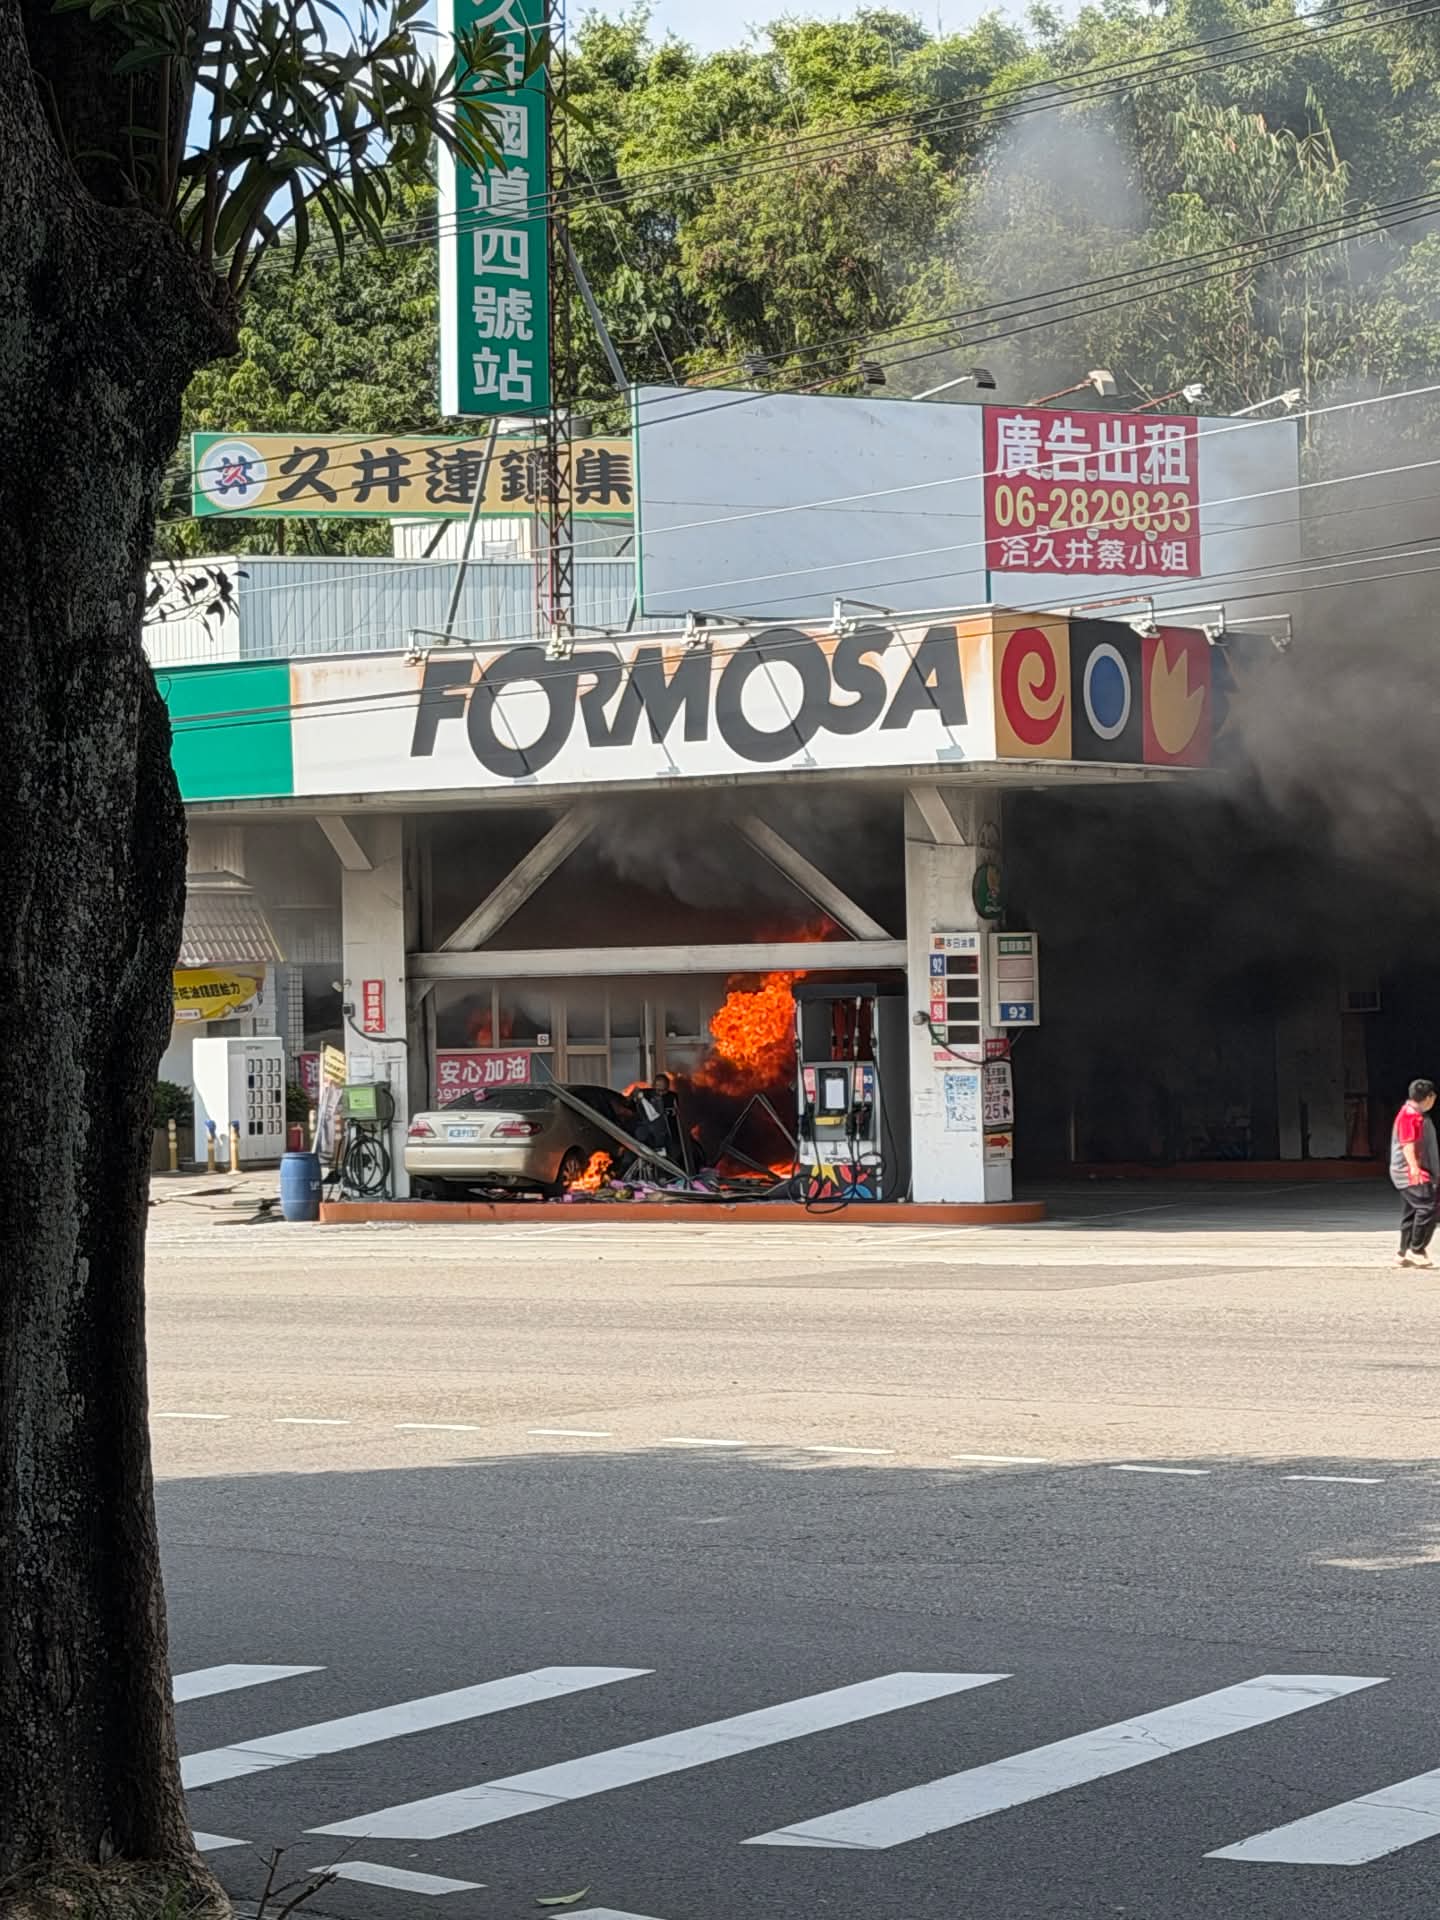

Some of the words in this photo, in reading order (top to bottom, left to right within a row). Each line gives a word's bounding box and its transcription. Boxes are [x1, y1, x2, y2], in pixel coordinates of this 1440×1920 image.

[995, 414, 1191, 485] 廣告出租
[994, 484, 1192, 533] 06-2829833
[1000, 536, 1189, 572] 洽久井蔡小姐
[410, 624, 969, 779] FORMOSA
[932, 957, 943, 974] 92
[1008, 1006, 1027, 1019] 92
[440, 1055, 527, 1085] 安心加油
[985, 1103, 1001, 1120] 25
